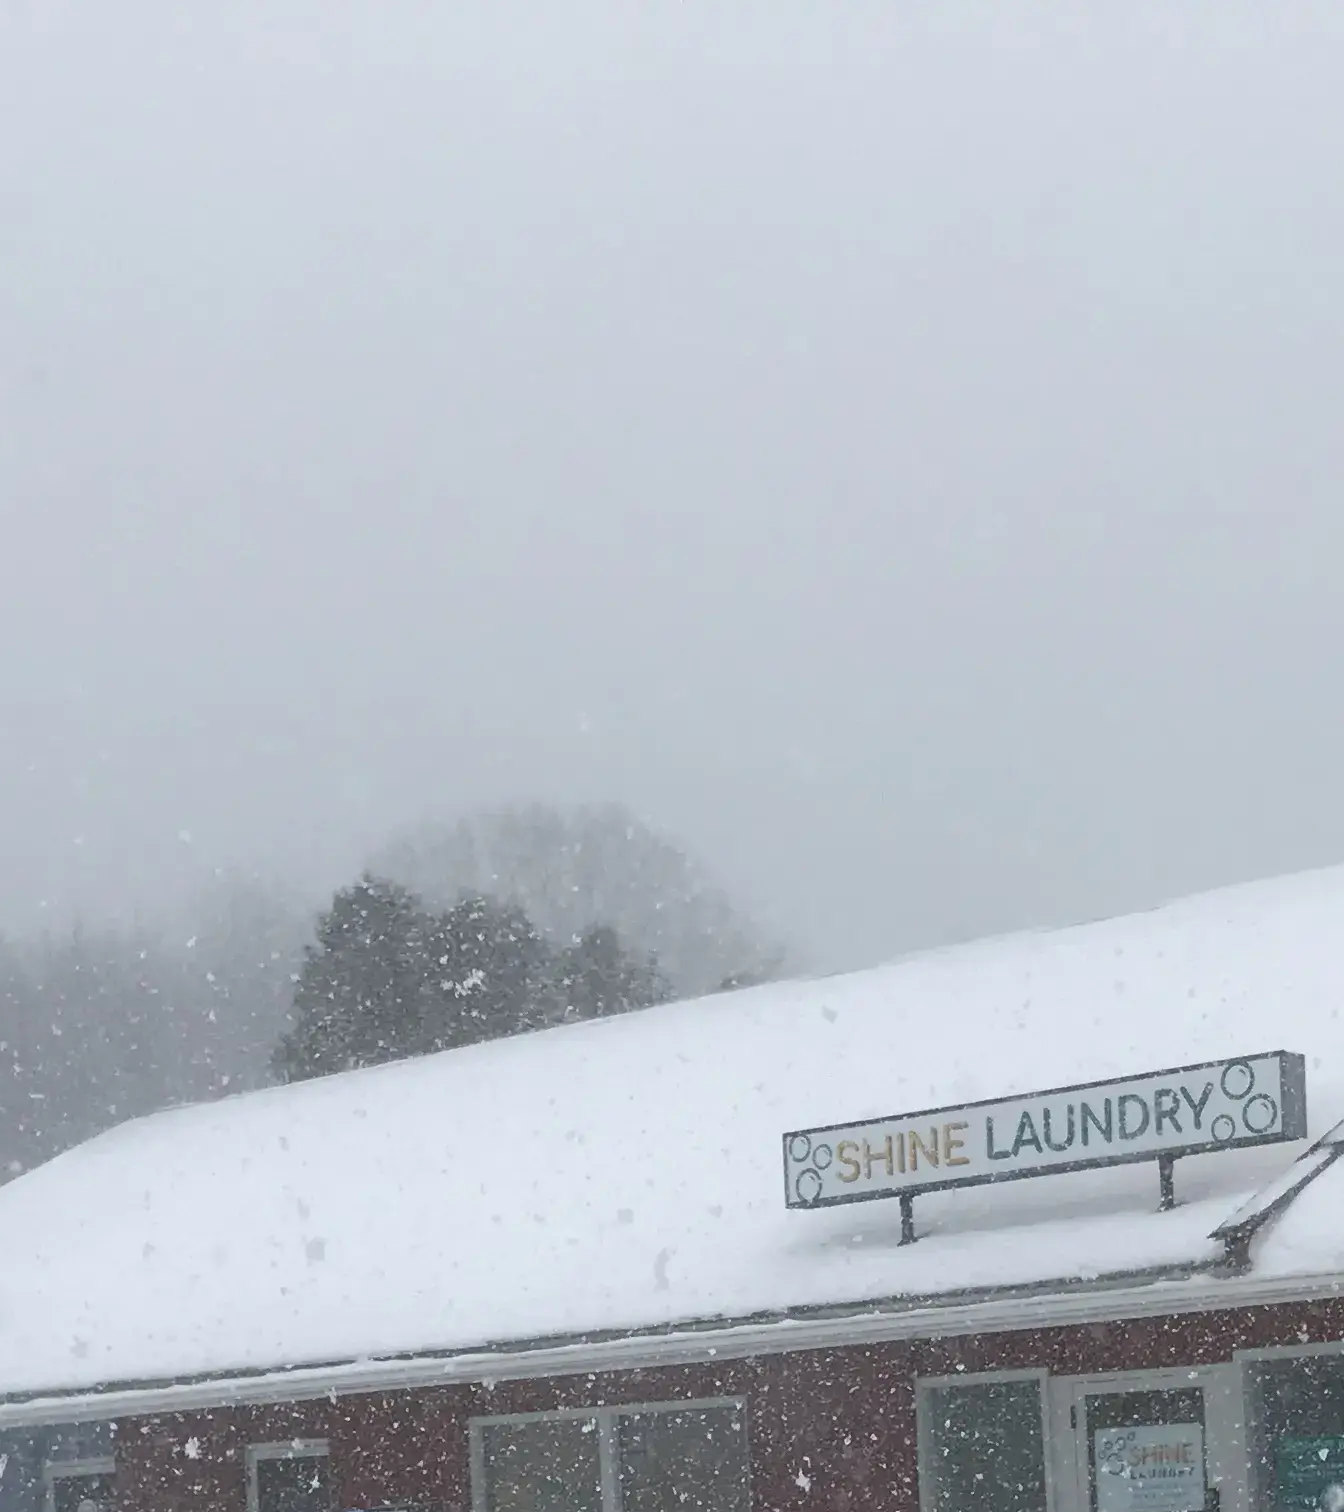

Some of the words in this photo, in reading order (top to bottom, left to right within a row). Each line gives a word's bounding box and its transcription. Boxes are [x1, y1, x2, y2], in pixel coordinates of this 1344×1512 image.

[835, 1120, 970, 1184] SHINE
[985, 1080, 1214, 1161] LAUNDRY
[1129, 1442, 1196, 1467] SHINE
